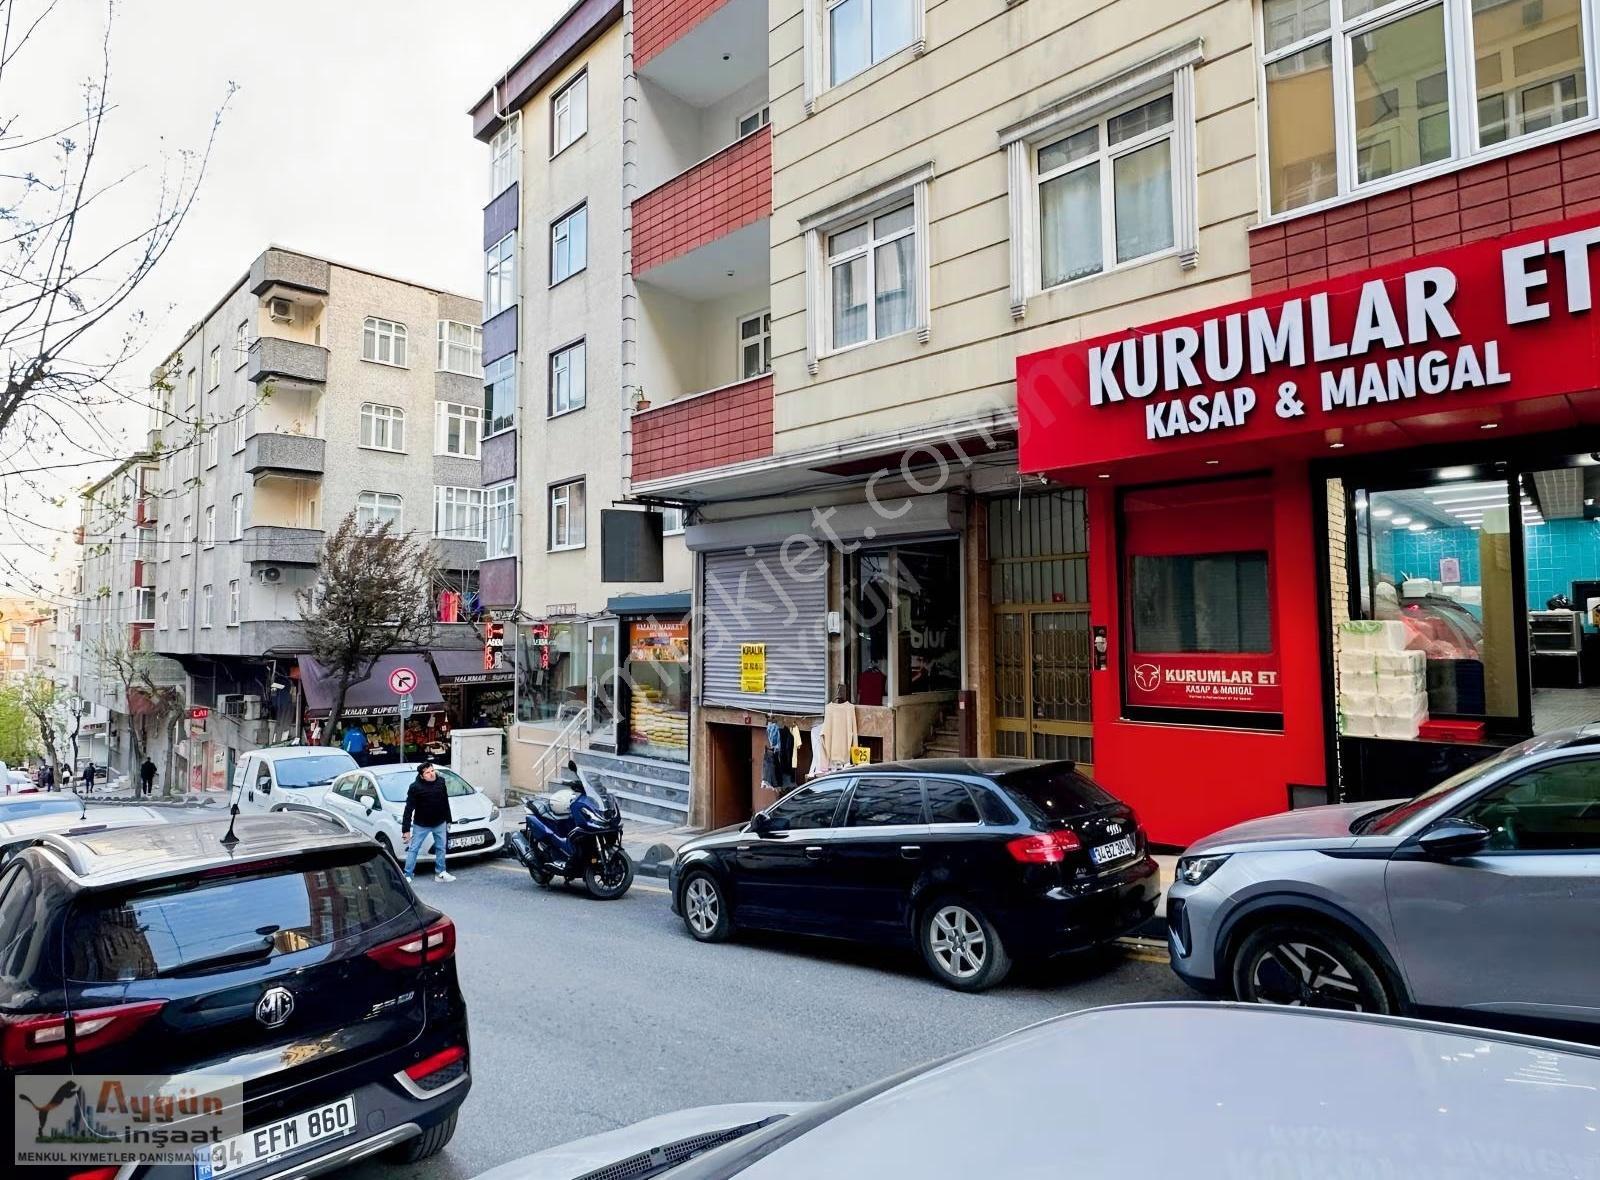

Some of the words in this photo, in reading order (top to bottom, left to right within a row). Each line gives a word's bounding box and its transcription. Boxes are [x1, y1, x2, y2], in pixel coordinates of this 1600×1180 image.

[1088, 265, 1462, 405] KURUMLAR
[1502, 226, 1600, 324] ET
[1146, 387, 1256, 440] KASAP
[1276, 382, 1305, 418] &
[1321, 340, 1511, 412] MANGAL
[1165, 669, 1253, 683] KURUMLAR
[1258, 671, 1277, 684] ET
[1186, 685, 1211, 694] KASAP
[253, 1119, 298, 1158] EFM
[307, 1103, 349, 1138] 860
